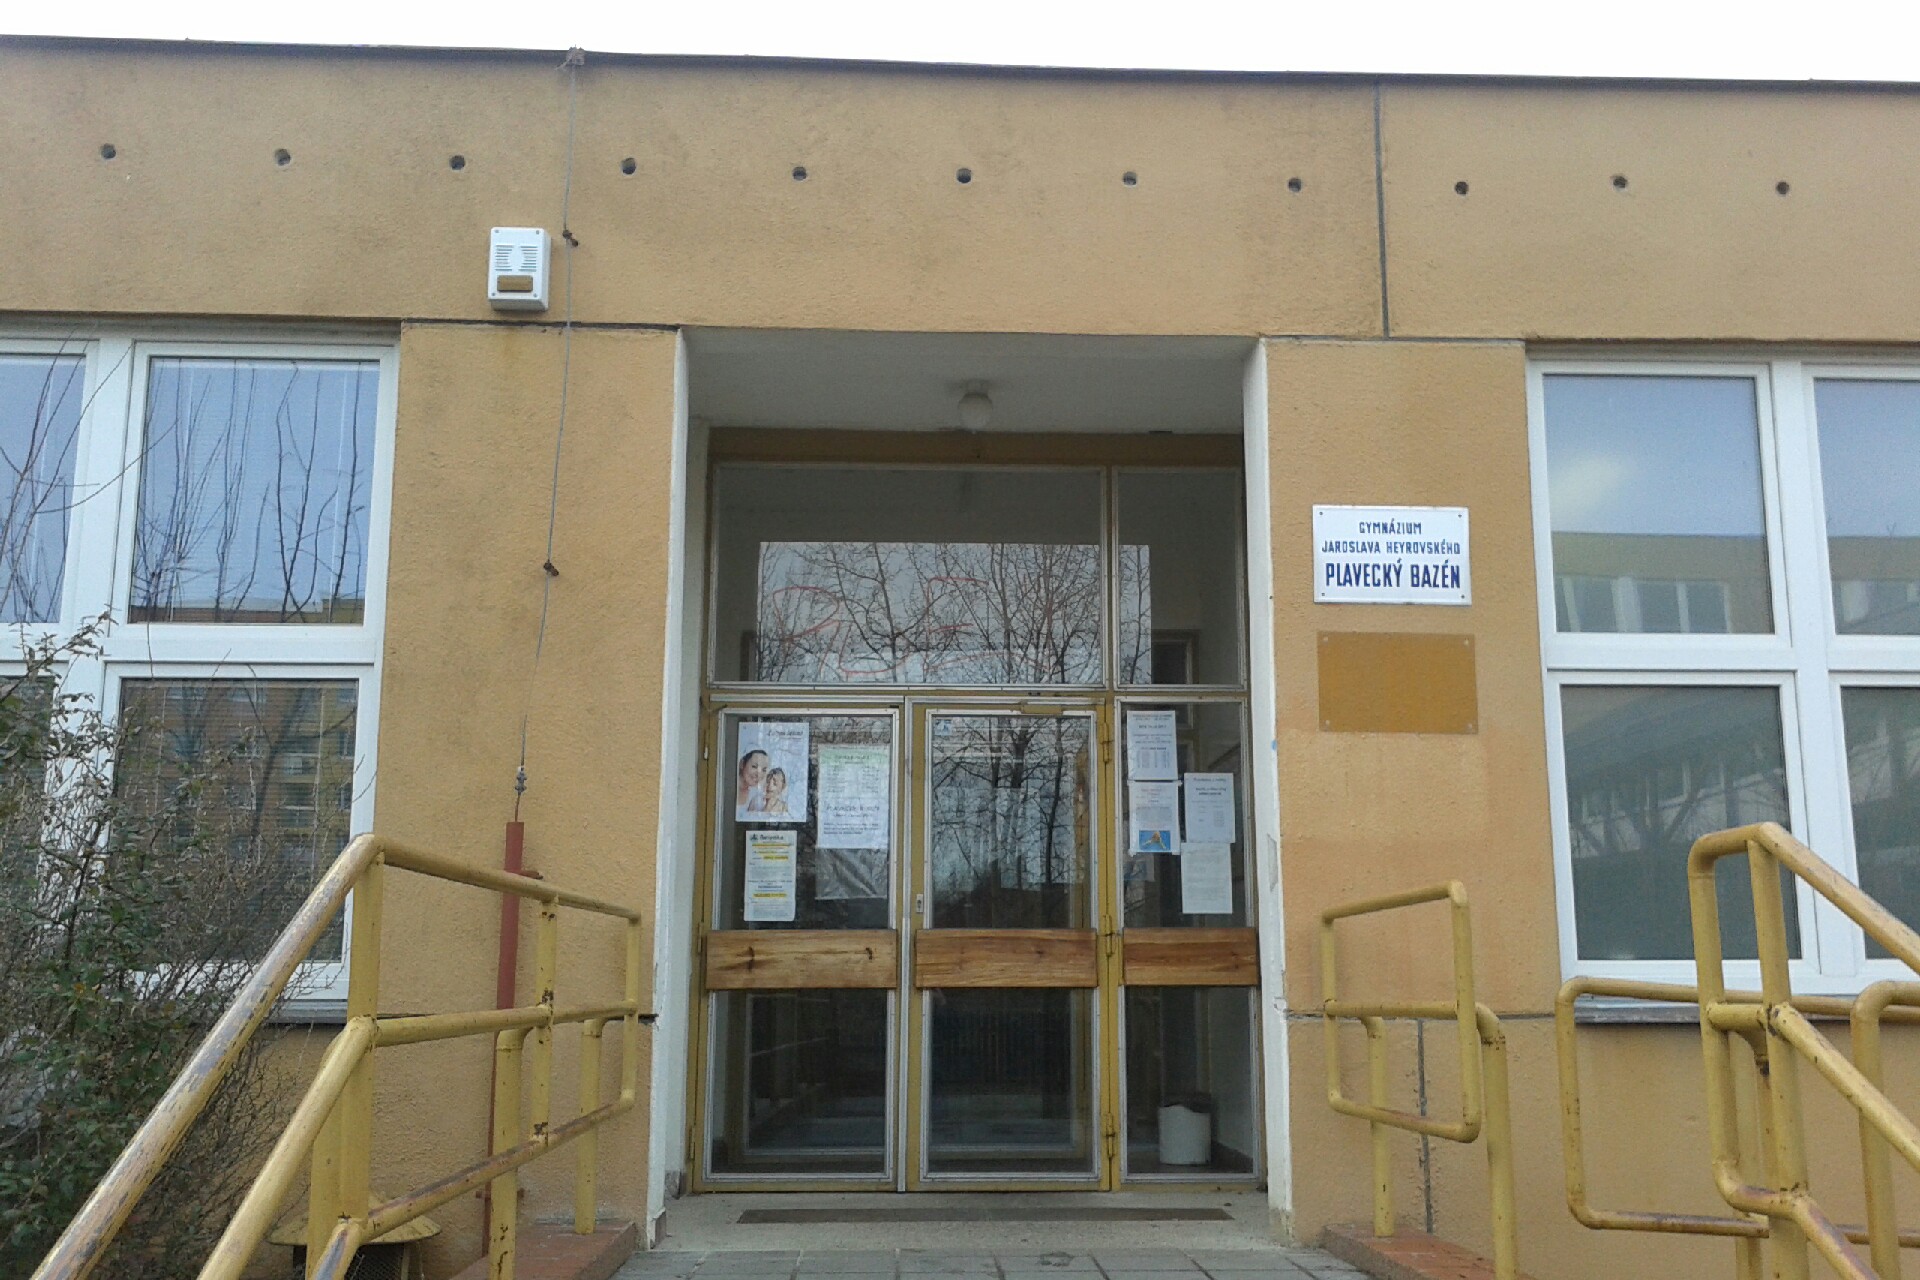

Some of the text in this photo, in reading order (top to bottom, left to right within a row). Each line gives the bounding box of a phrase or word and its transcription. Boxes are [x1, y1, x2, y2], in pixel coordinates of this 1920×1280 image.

[1359, 518, 1422, 535] GYMNÁZIUM
[1322, 538, 1461, 555] JAROSLAVA HEYROVSKÉHO
[1325, 557, 1461, 589] PLAVECKÝ BAZÉN
